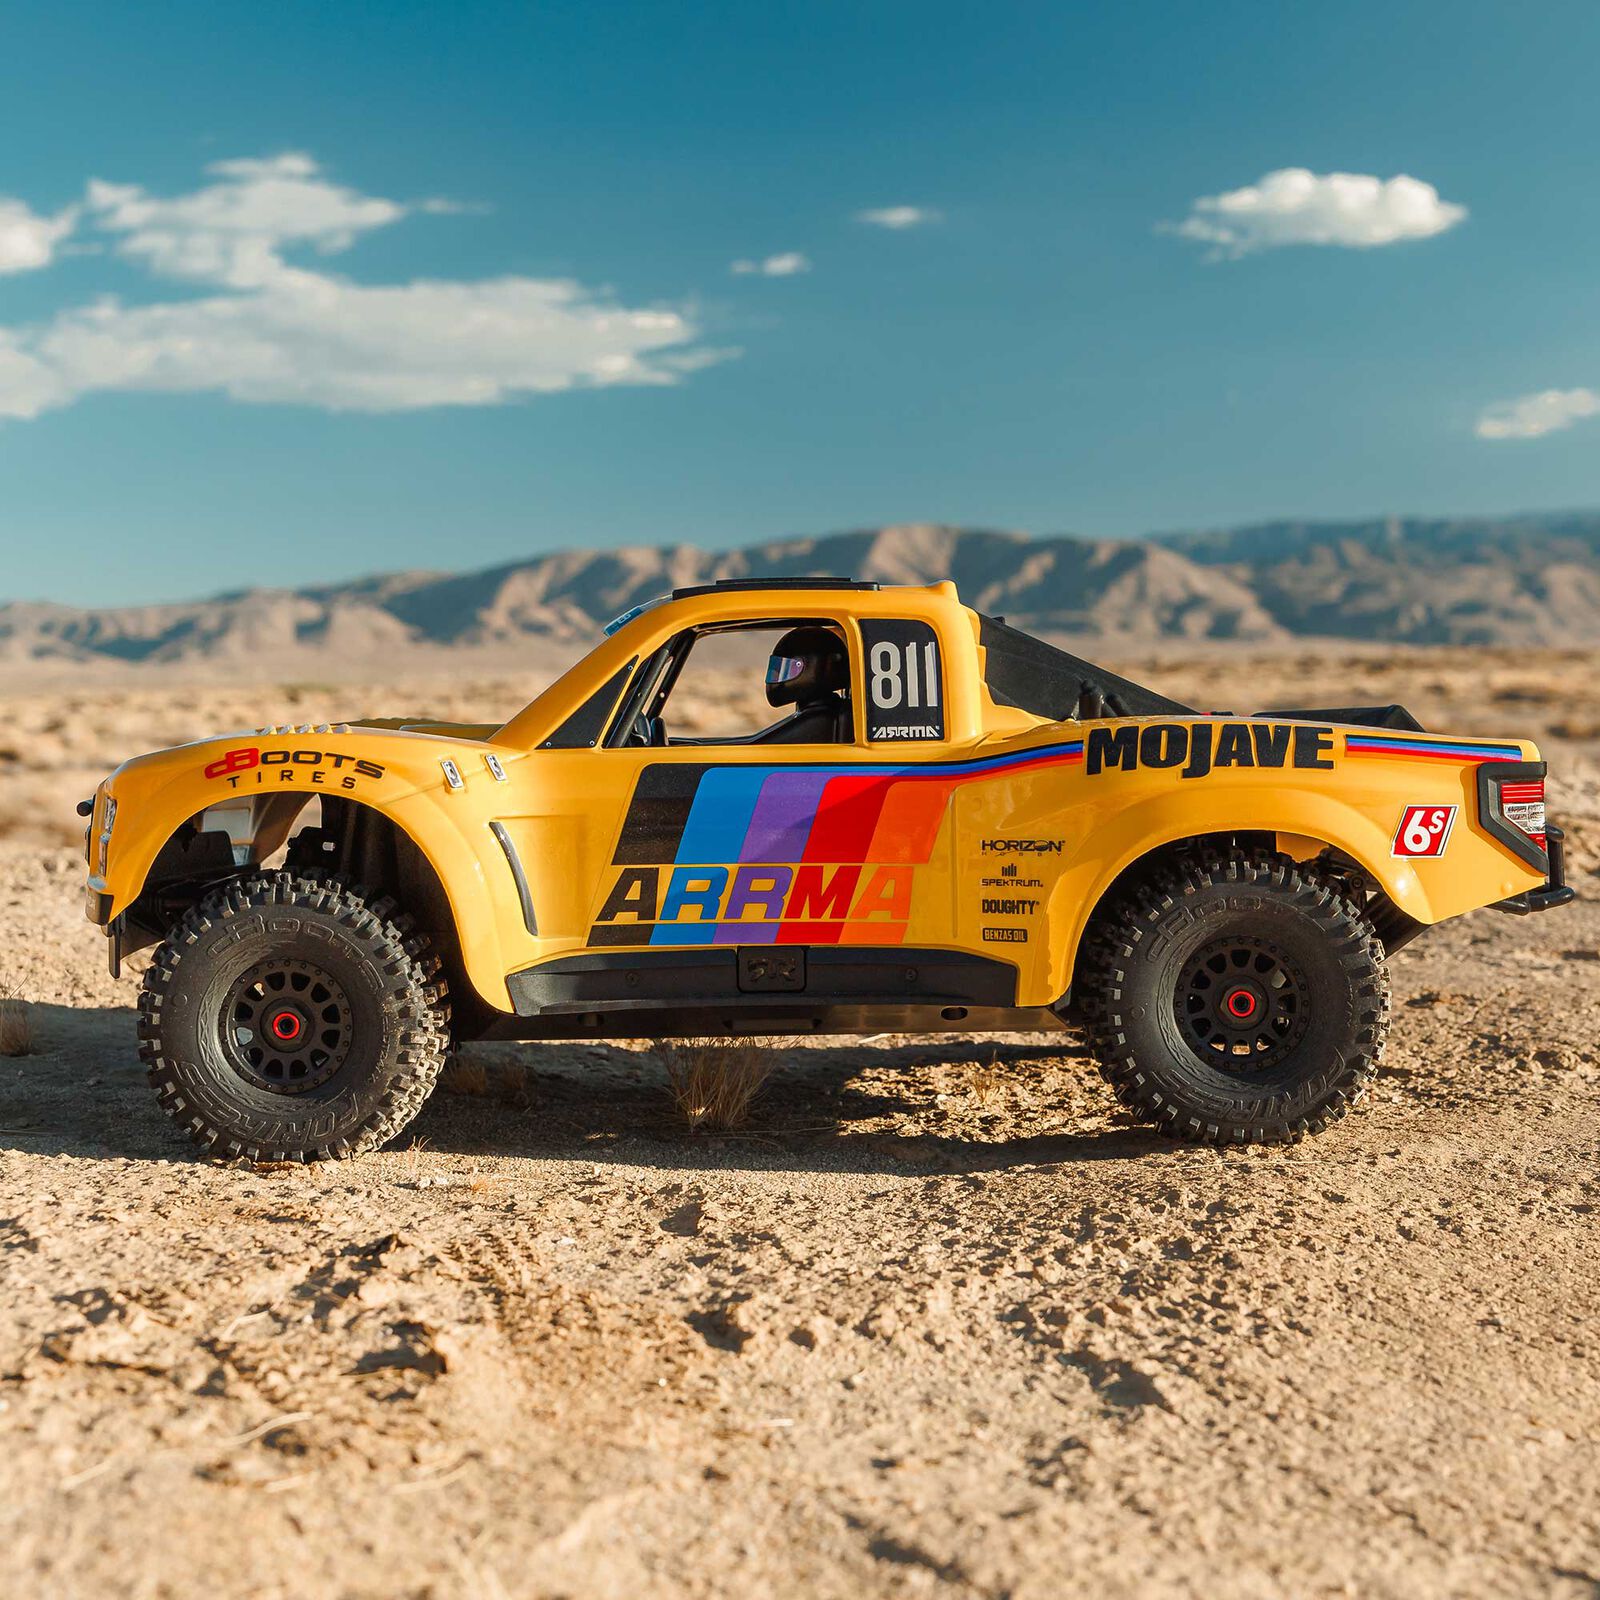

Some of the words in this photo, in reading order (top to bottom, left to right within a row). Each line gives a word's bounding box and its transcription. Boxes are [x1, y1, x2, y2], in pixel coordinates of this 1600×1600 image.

[870, 641, 938, 709] 811
[1087, 723, 1334, 778] MOJAVE
[227, 769, 357, 789] TIRES
[982, 840, 1062, 852] HORIZON
[982, 879, 1041, 887] SPEKTRUM
[595, 865, 915, 922] ARRMA
[982, 899, 1035, 915] DOUGHTY
[1013, 931, 1026, 941] OIL
